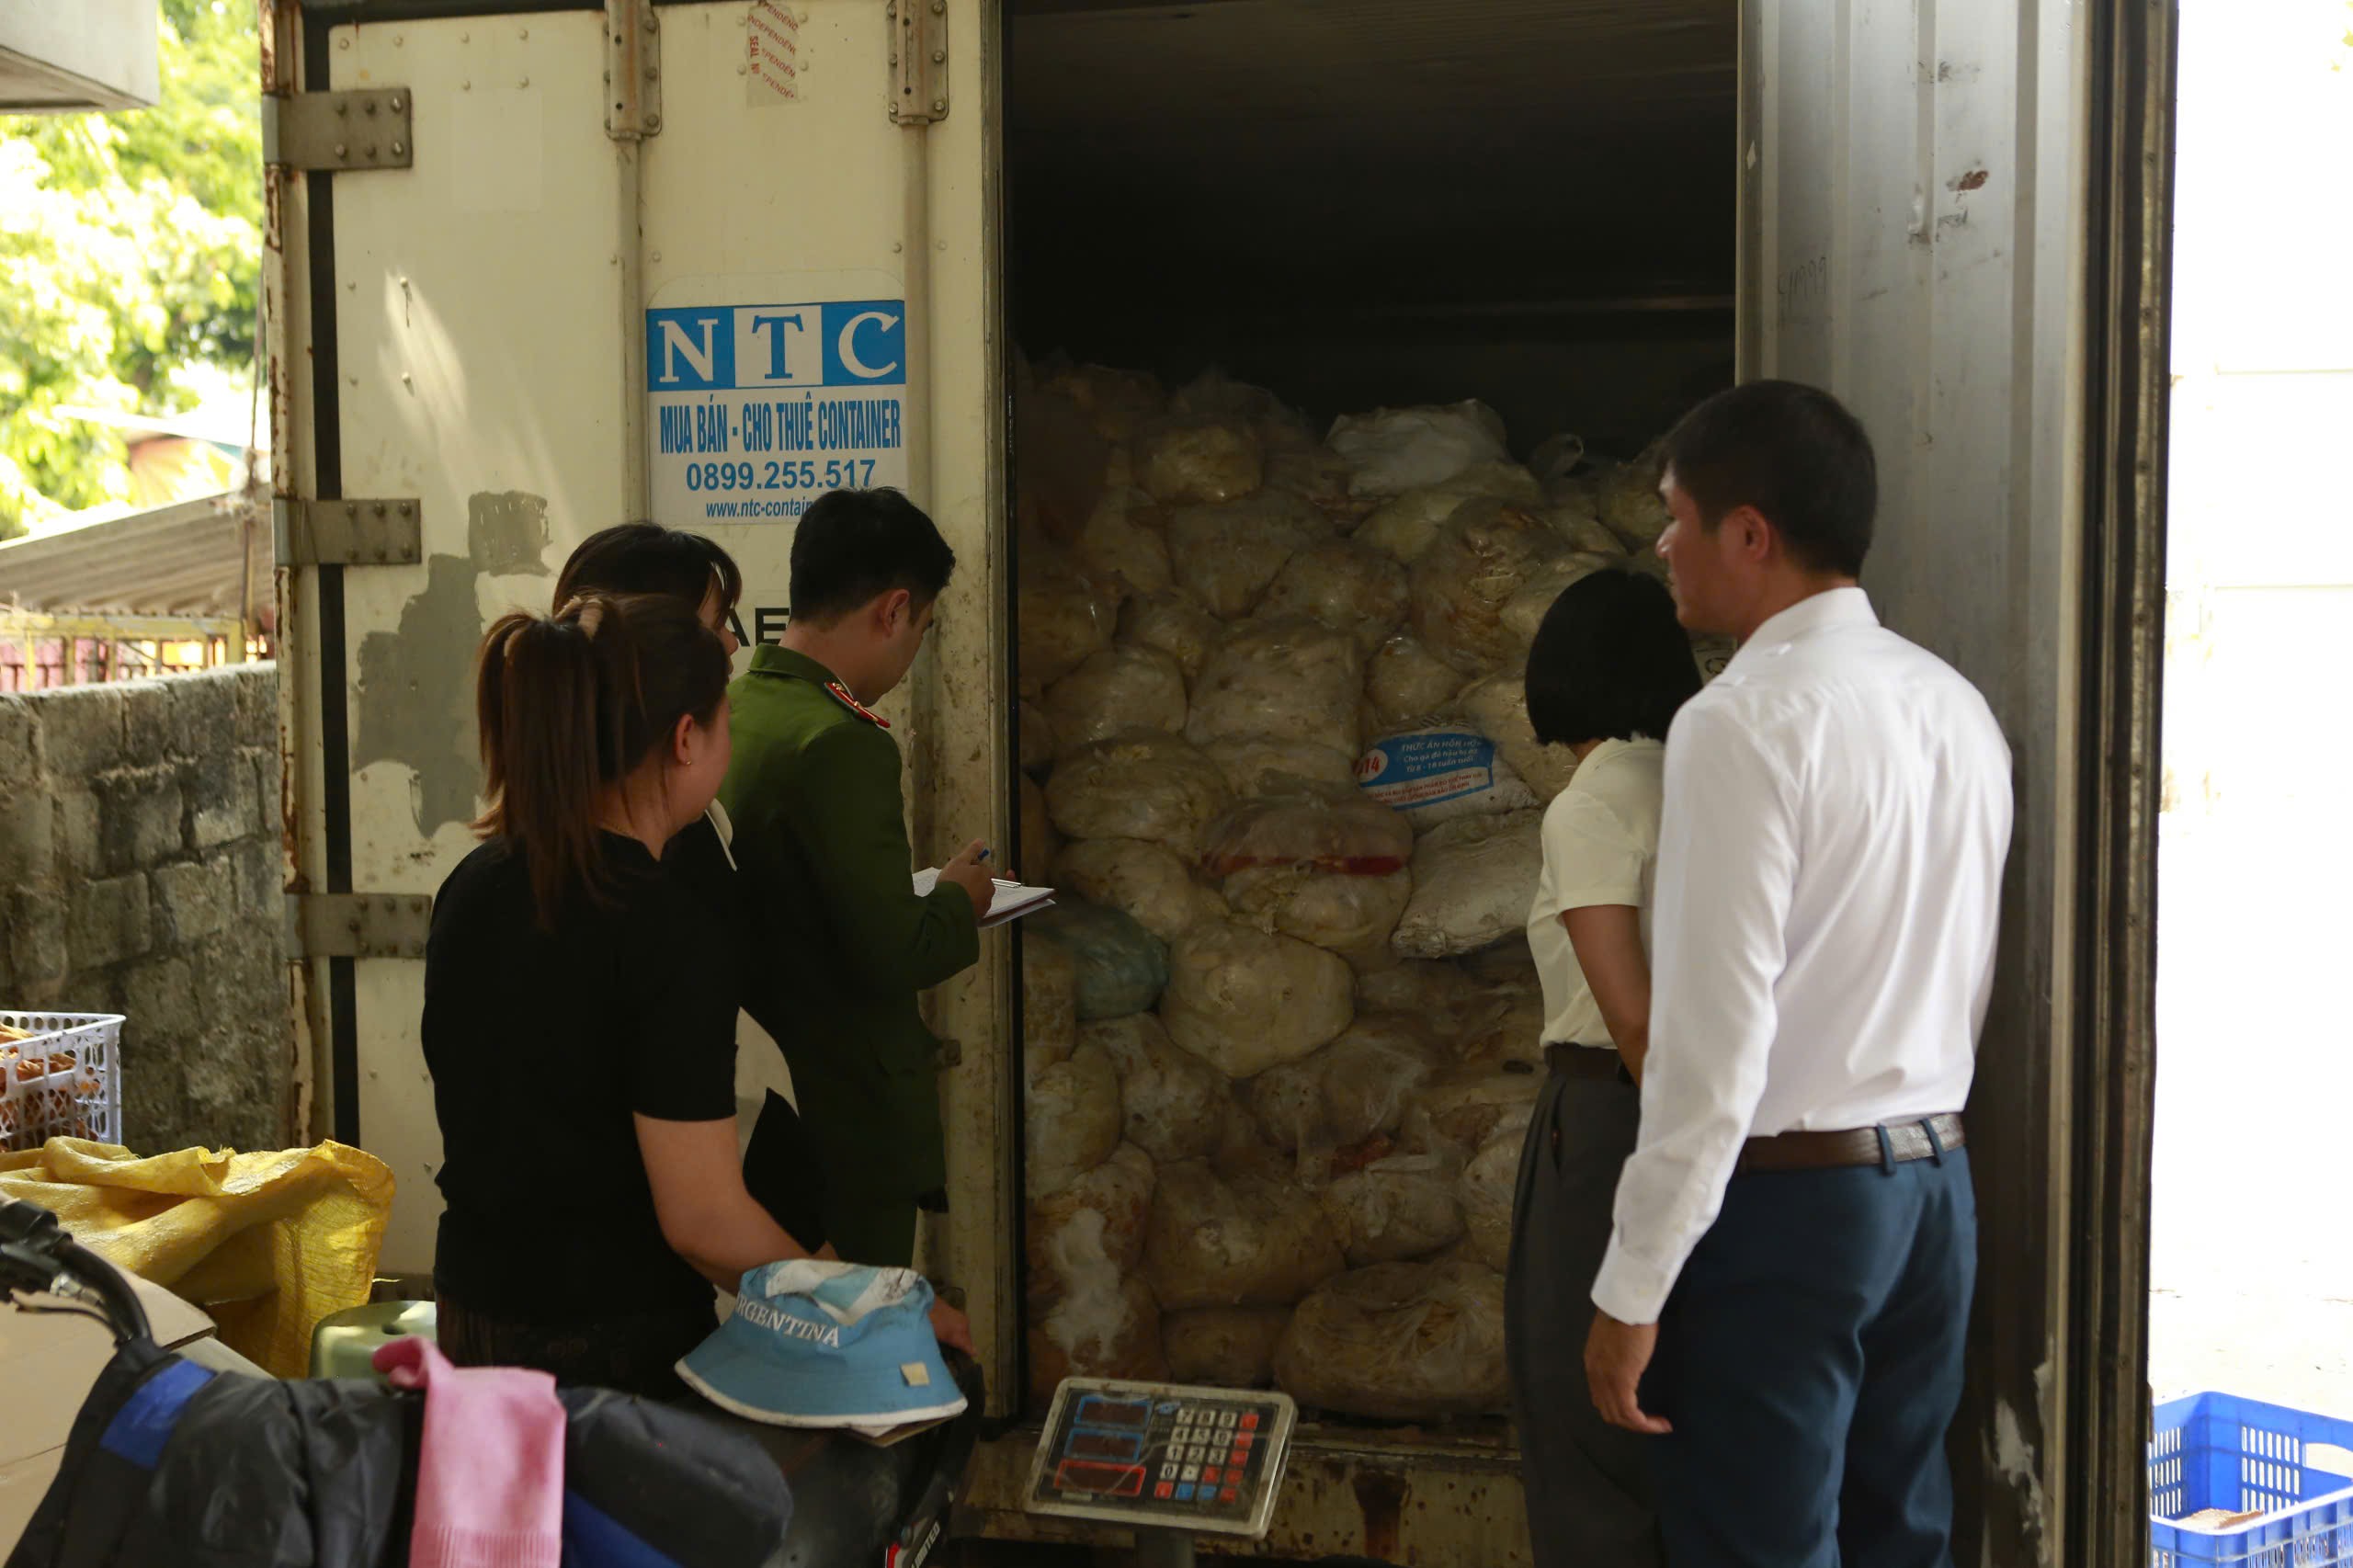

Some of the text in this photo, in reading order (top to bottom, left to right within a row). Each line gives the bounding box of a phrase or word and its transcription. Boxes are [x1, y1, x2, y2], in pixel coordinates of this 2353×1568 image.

[658, 311, 900, 382] NTC
[660, 404, 693, 454] MUA
[697, 393, 728, 453] BÁN
[742, 403, 772, 452] CHO
[776, 391, 813, 450] THUÊ
[818, 399, 901, 449] CONTAINER
[686, 459, 876, 491] 0899.255.517
